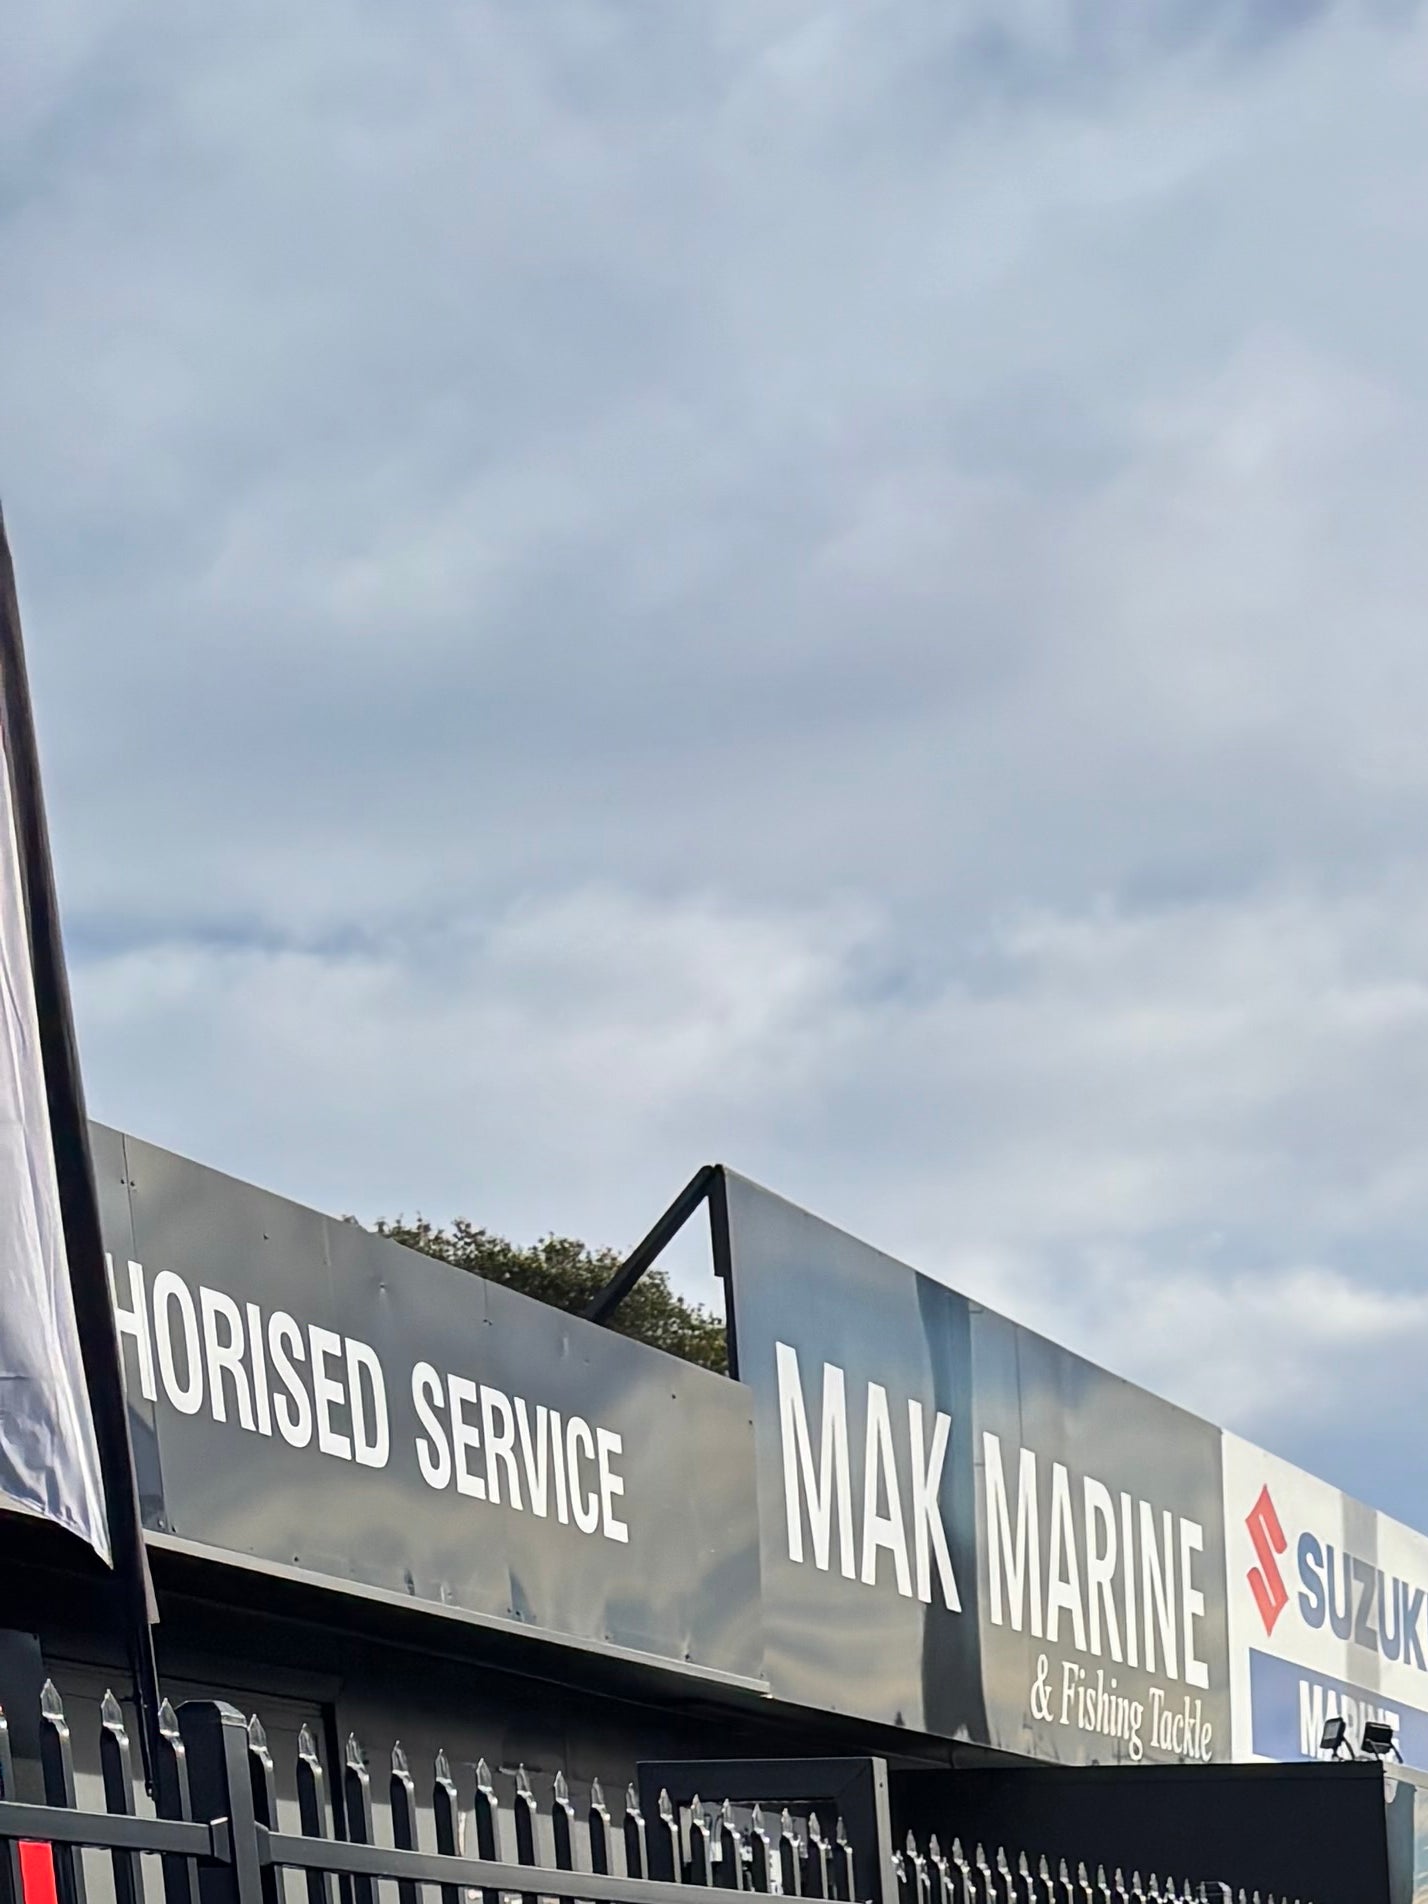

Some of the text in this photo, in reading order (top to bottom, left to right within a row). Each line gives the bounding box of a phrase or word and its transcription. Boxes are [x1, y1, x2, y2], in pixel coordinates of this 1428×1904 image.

[105, 1251, 628, 1544] HORISED SERVICE
[775, 1341, 1209, 1690] MAK MARINE
[1030, 1653, 1214, 1763] & Fishing Tackle
